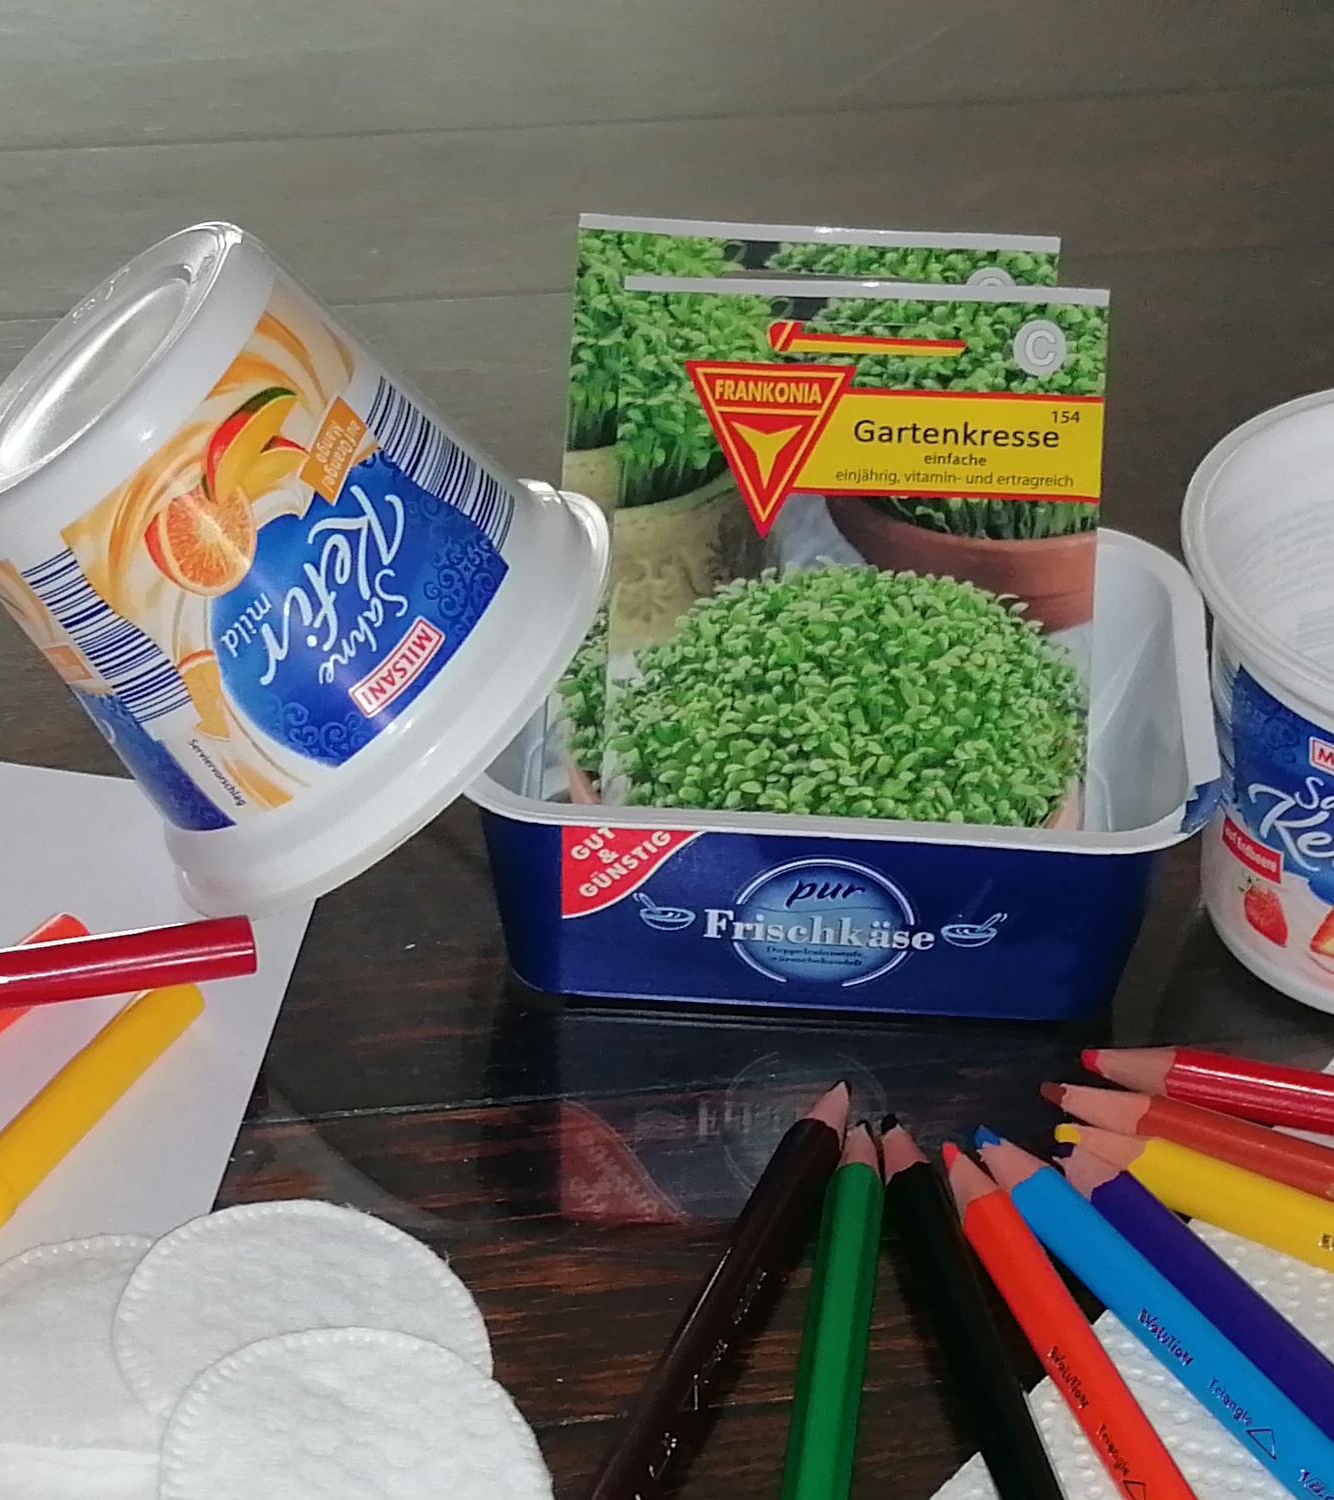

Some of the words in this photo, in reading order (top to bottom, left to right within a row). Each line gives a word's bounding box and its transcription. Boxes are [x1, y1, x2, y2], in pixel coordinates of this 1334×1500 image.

[714, 379, 822, 405] FRANKONIA
[1051, 409, 1081, 425] 154
[853, 419, 1060, 450] Gartenkresse
[923, 452, 987, 468] einfache
[835, 467, 900, 487] einjährig,
[904, 470, 963, 485] vitamin-
[965, 470, 994, 486] und
[997, 472, 1074, 490] ertragreich
[259, 484, 405, 686] Kefir
[219, 592, 273, 658] mild
[319, 568, 409, 685] Sahne
[360, 626, 434, 706] MILSANI
[187, 738, 247, 807] Serviervorschlag
[569, 827, 619, 861] GUT
[597, 848, 619, 865] &
[578, 829, 672, 898] GÜNSTIG
[783, 878, 869, 908] pur
[702, 908, 936, 952] Frischkäse
